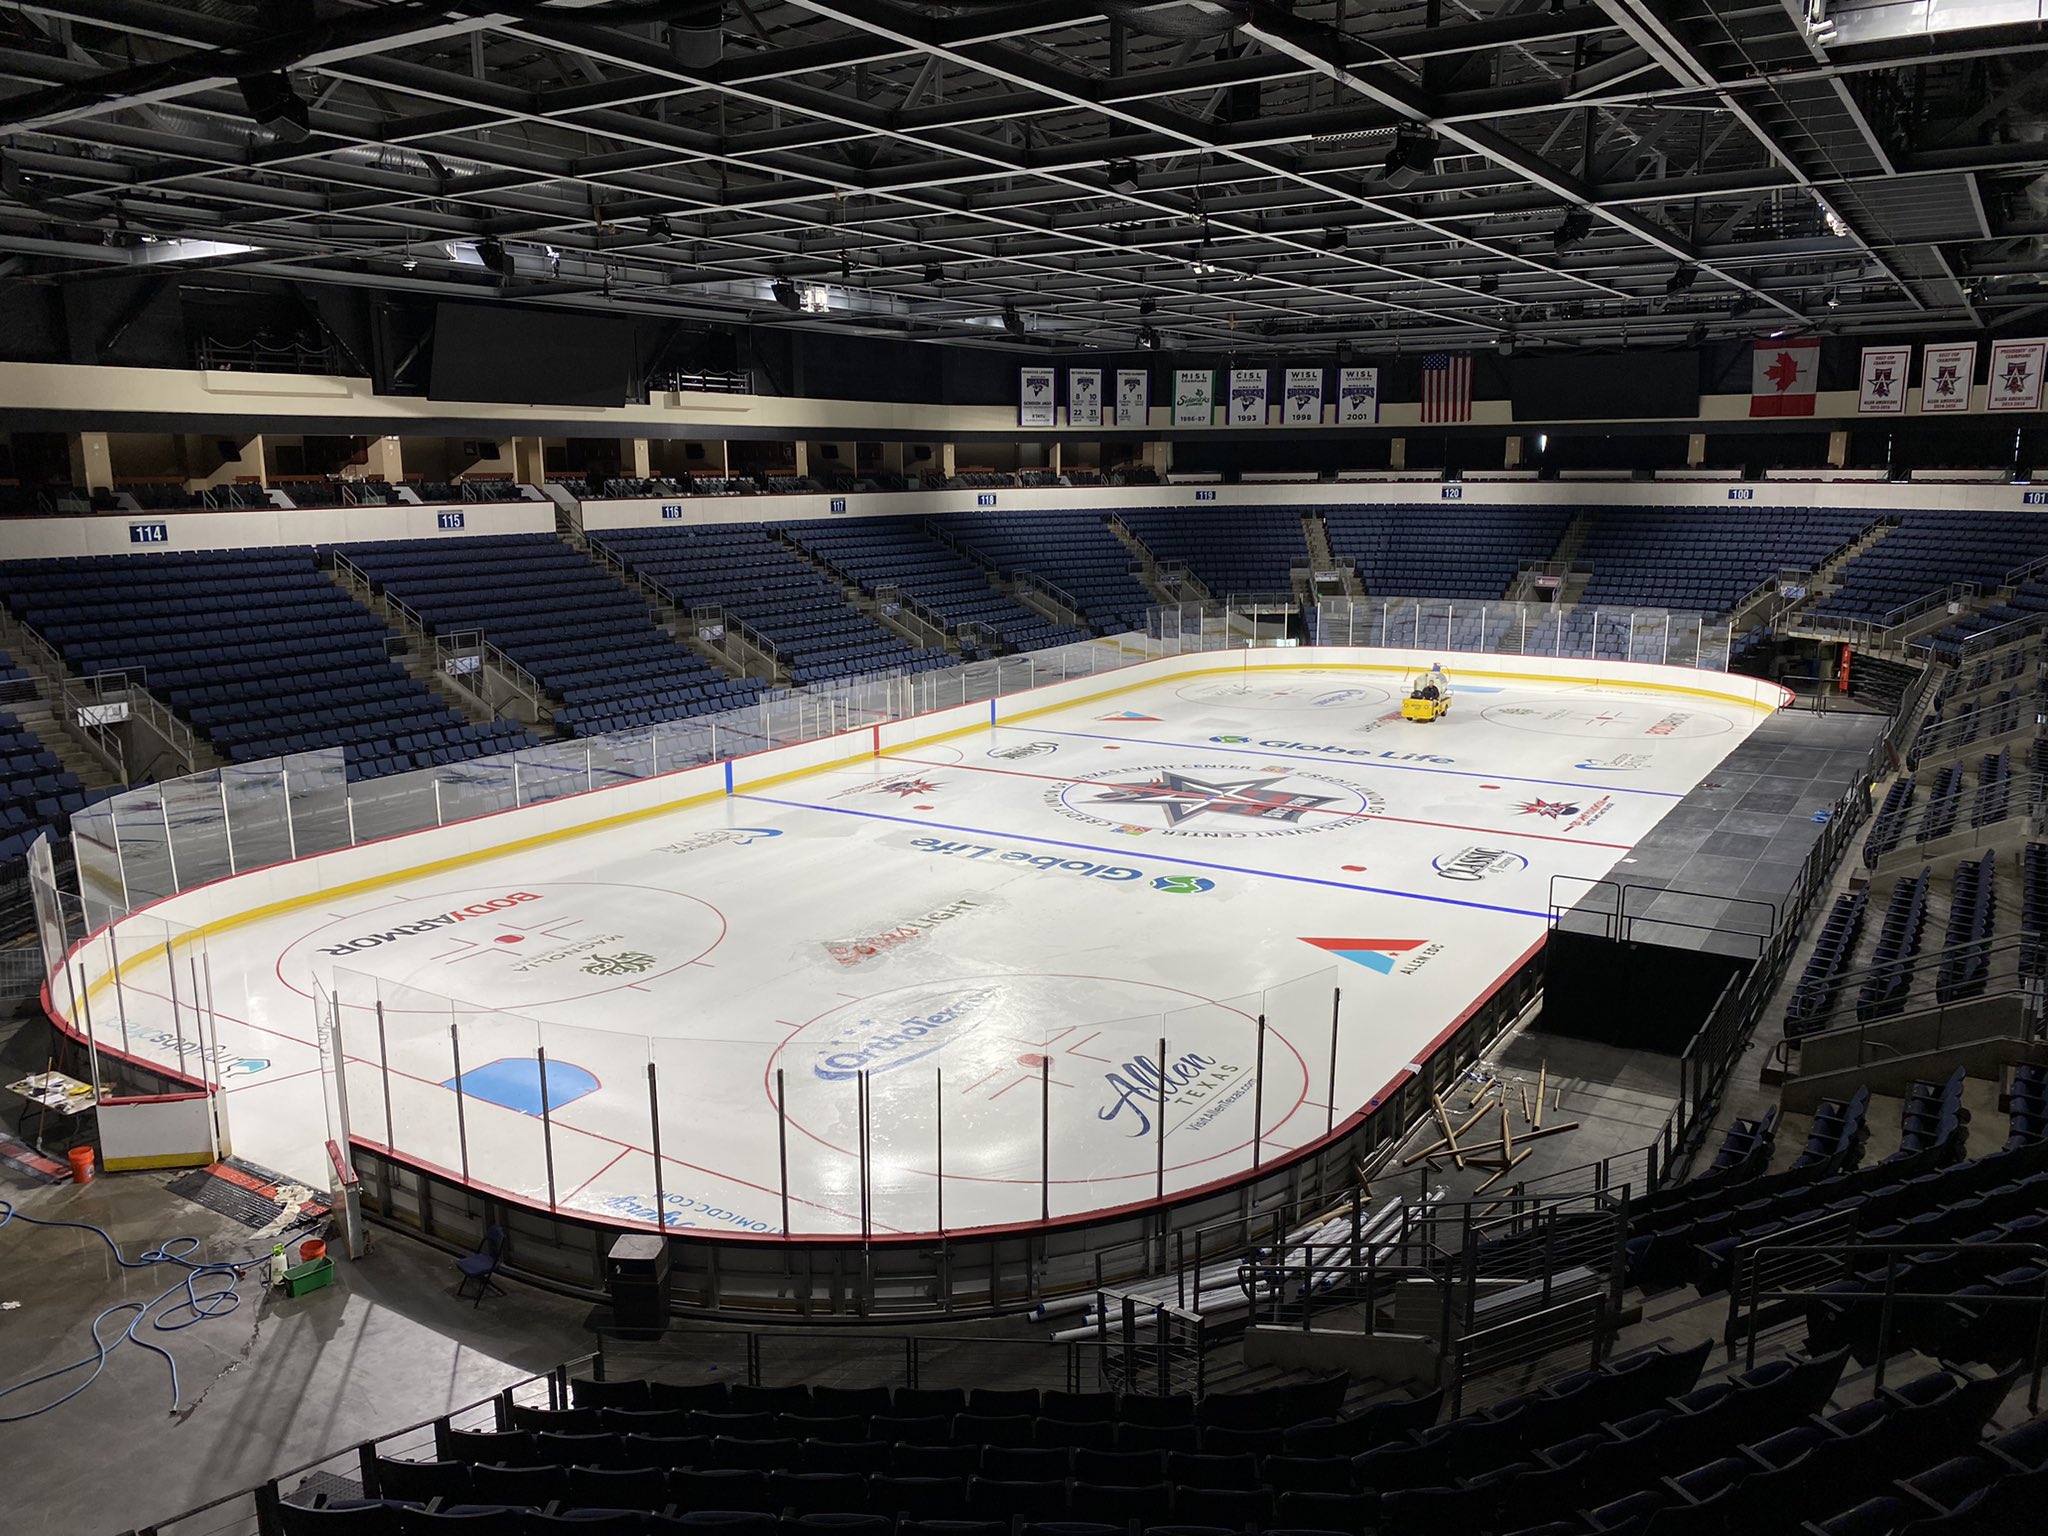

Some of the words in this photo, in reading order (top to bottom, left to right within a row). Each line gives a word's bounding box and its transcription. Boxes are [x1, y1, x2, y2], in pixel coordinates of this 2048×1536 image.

[981, 495, 995, 505] 118
[1199, 491, 1213, 500] 119
[1445, 488, 1460, 498] 120
[1732, 489, 1749, 499] 100
[2028, 492, 2046, 504] 101
[665, 506, 679, 518] 116
[833, 500, 844, 511] 117
[442, 514, 461, 528] 115
[136, 526, 162, 542] 114
[1258, 739, 1371, 756] Globe
[1378, 751, 1455, 764] Life
[1121, 764, 1176, 773] EVENT
[1295, 771, 1361, 787] CREDIT
[1161, 829, 1247, 839] CENTER
[1256, 827, 1322, 838] EVENT
[910, 837, 998, 859] Life
[1000, 850, 1144, 881] Globe
[1437, 846, 1506, 882] CLASSIC
[906, 899, 981, 929] LIGHT
[316, 892, 544, 956] BODYARMOR
[513, 934, 625, 973] MAGNOLIA
[1400, 954, 1431, 975] ALLEN
[1422, 942, 1445, 956] EDC
[1174, 1064, 1239, 1106] TEXAS
[1098, 1053, 1217, 1138] Allen
[1185, 1077, 1258, 1132] VisitAllenTexas.com
